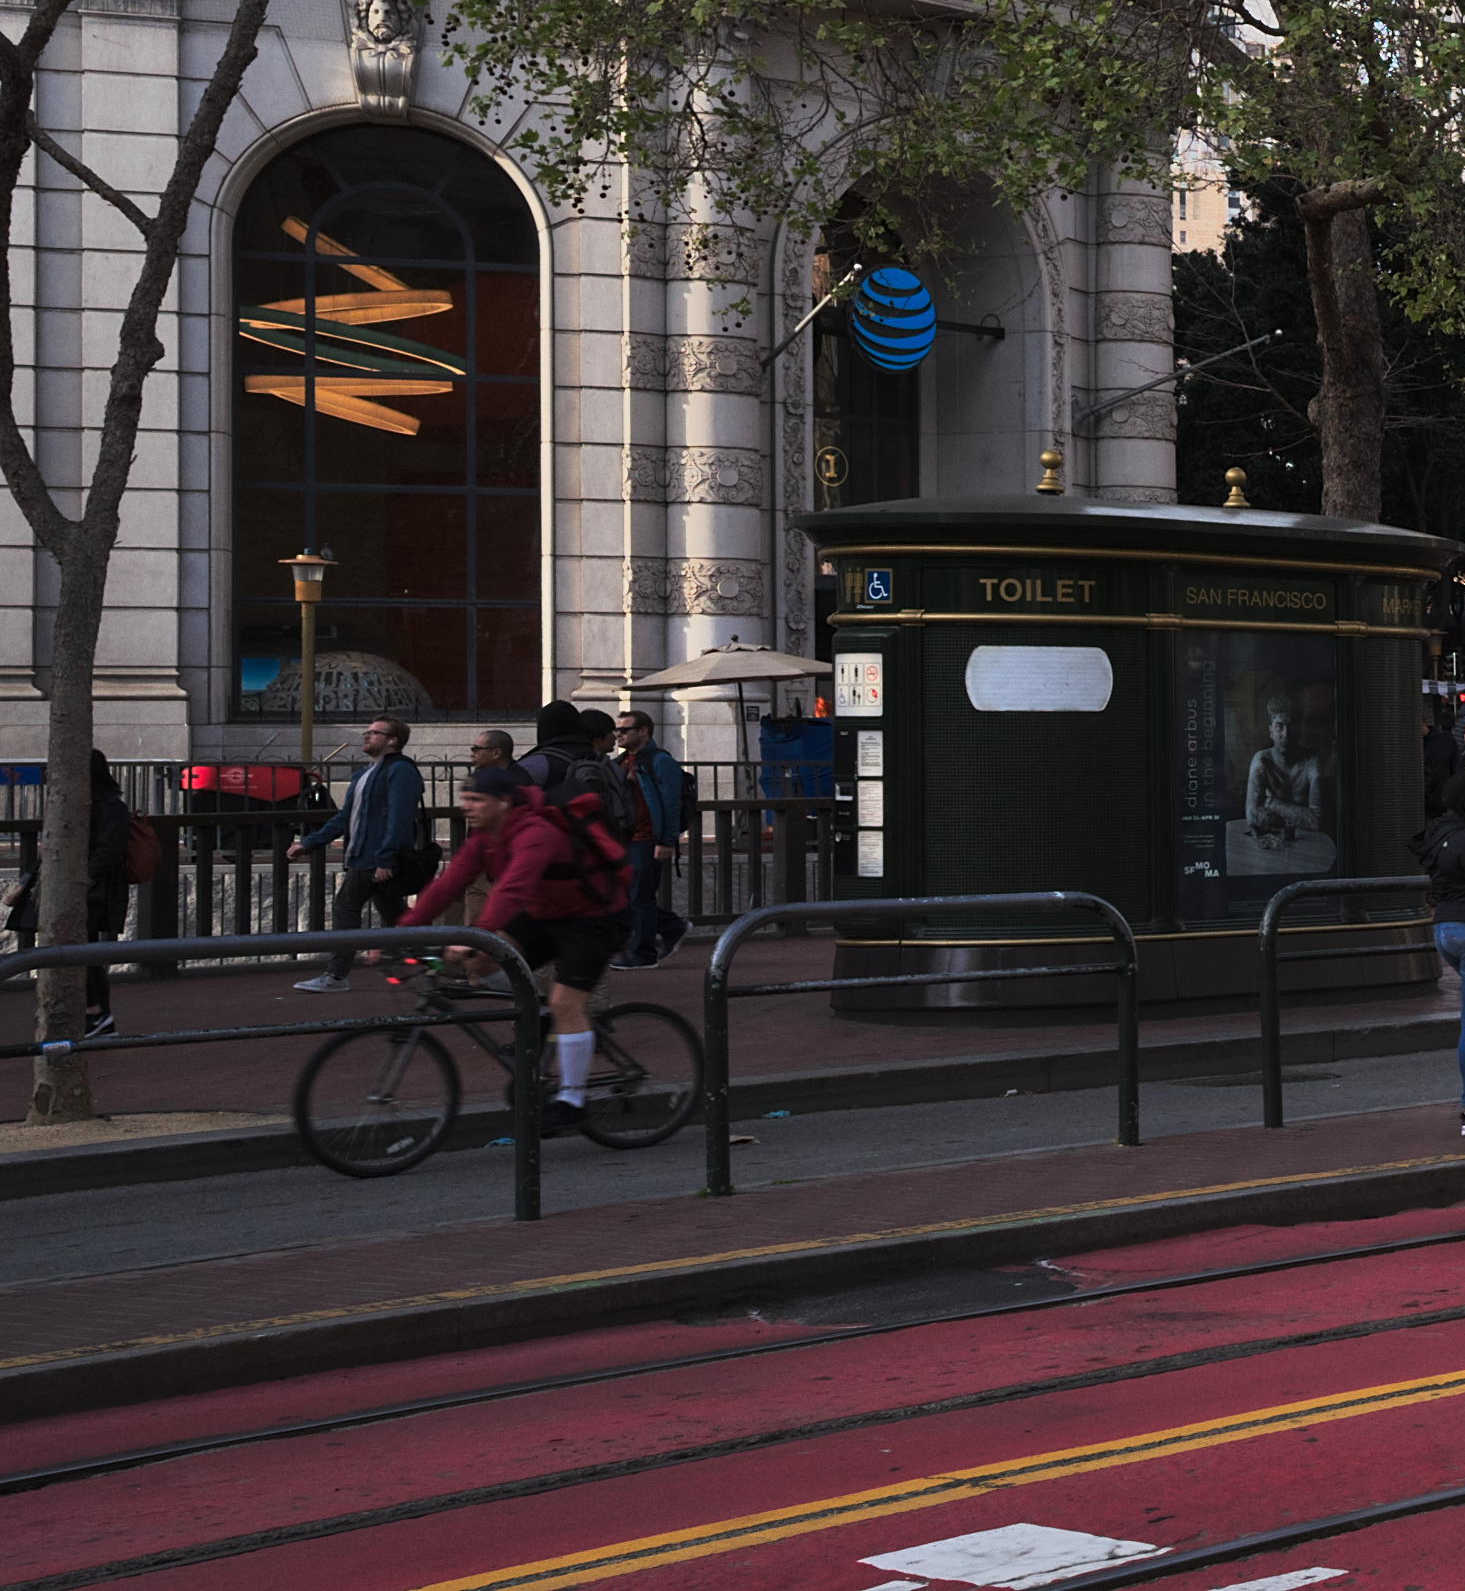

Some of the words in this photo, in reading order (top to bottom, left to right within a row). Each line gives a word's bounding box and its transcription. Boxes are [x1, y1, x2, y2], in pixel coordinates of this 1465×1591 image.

[979, 578, 1096, 603] TOILET
[1186, 587, 1222, 606] SAN
[1227, 589, 1327, 610] FRANCISCO
[1200, 660, 1217, 750] beginning
[1184, 698, 1198, 752] arbus
[1184, 756, 1198, 808] diane
[1200, 756, 1214, 786] the
[1201, 792, 1214, 807] in
[1184, 866, 1195, 875] SF
[1195, 861, 1210, 870] MO
[1204, 869, 1220, 877] MA
